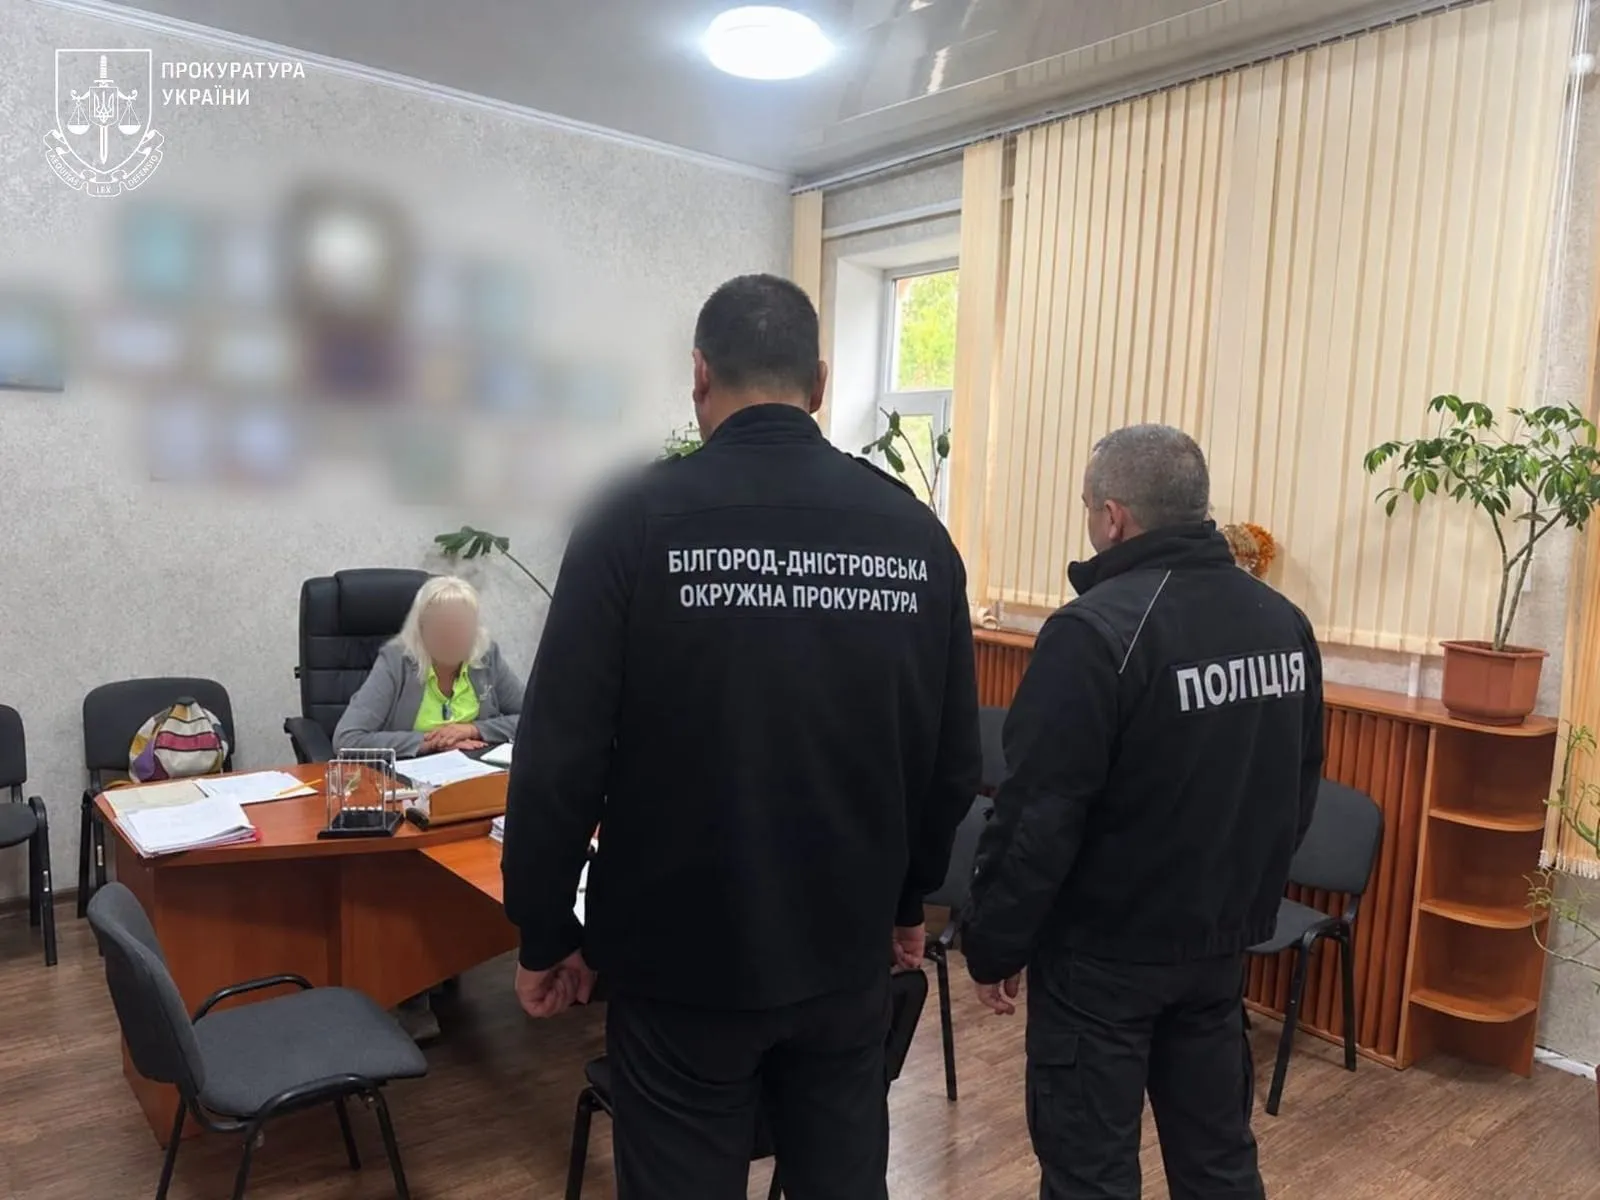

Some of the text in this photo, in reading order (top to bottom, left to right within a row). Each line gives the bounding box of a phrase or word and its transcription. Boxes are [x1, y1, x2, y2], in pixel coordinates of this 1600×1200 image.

[668, 548, 928, 581] БІЛГОРОД-ДНІСТРОВСЬКА
[680, 584, 918, 613] ОКРУЖНА ПРОКУРАТУРА
[1176, 652, 1305, 712] ПОЛІЦІЯ
